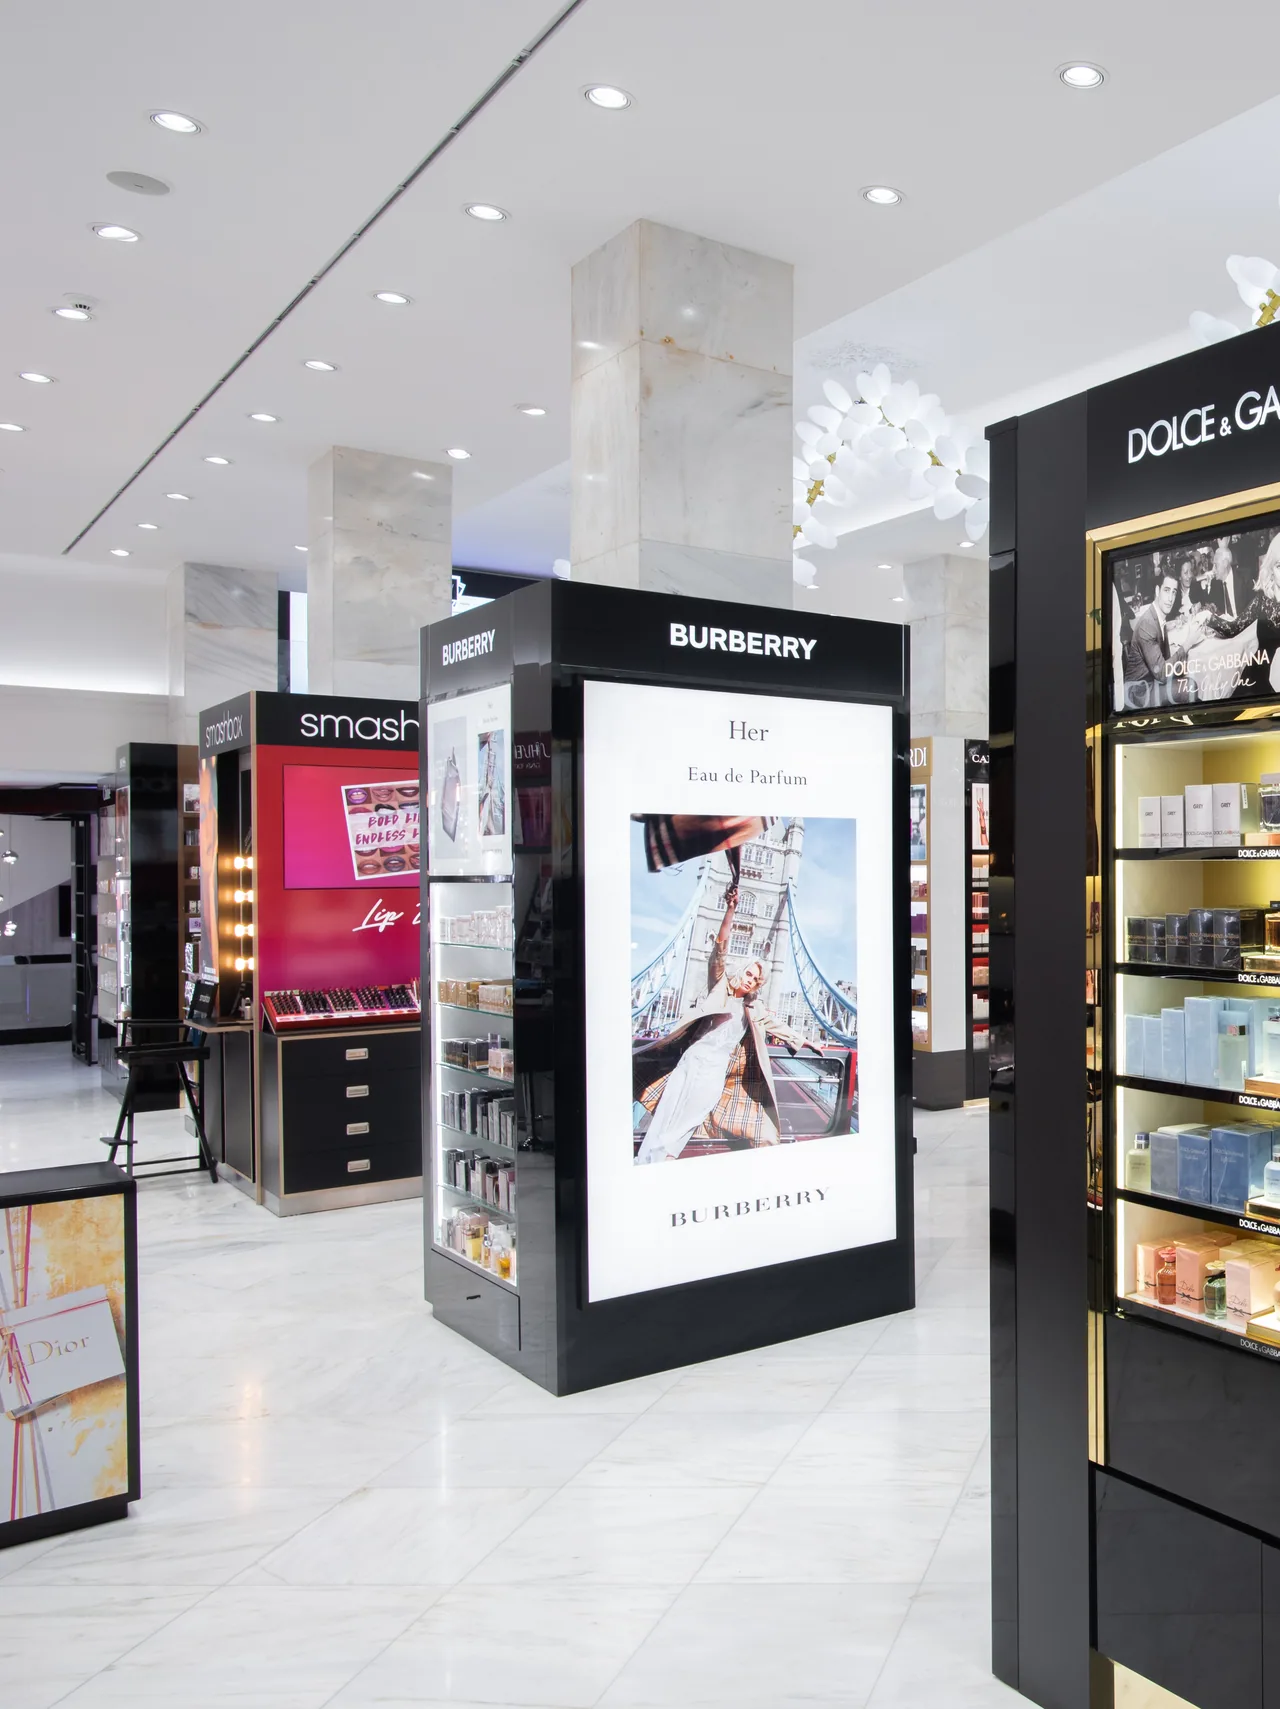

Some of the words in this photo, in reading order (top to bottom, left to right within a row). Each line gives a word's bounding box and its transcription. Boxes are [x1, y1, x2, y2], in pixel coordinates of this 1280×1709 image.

[1127, 404, 1215, 464] DOLCE
[1219, 416, 1232, 437] &
[442, 629, 496, 666] BURBERRY
[669, 622, 817, 660] BURBERRY
[1165, 661, 1201, 677] DOLCE
[1208, 649, 1270, 671] GABBANA
[1177, 678, 1199, 694] The
[1200, 676, 1228, 696] Only
[1231, 671, 1257, 688] One
[205, 710, 244, 748] smashbox
[729, 720, 770, 742] Her
[688, 766, 718, 783] Eau
[724, 768, 744, 784] de
[750, 769, 808, 787] Parfum
[368, 814, 399, 828] BOLD
[355, 829, 406, 845] ENDLESS
[352, 898, 404, 932] Lip
[1238, 974, 1257, 983] DOLCE
[1238, 1095, 1258, 1107] DOLCE
[668, 1186, 830, 1228] BURBERRY
[1239, 1218, 1258, 1231] DOLCE
[24, 1336, 90, 1367] Dior
[1240, 1338, 1258, 1351] DOLCE
